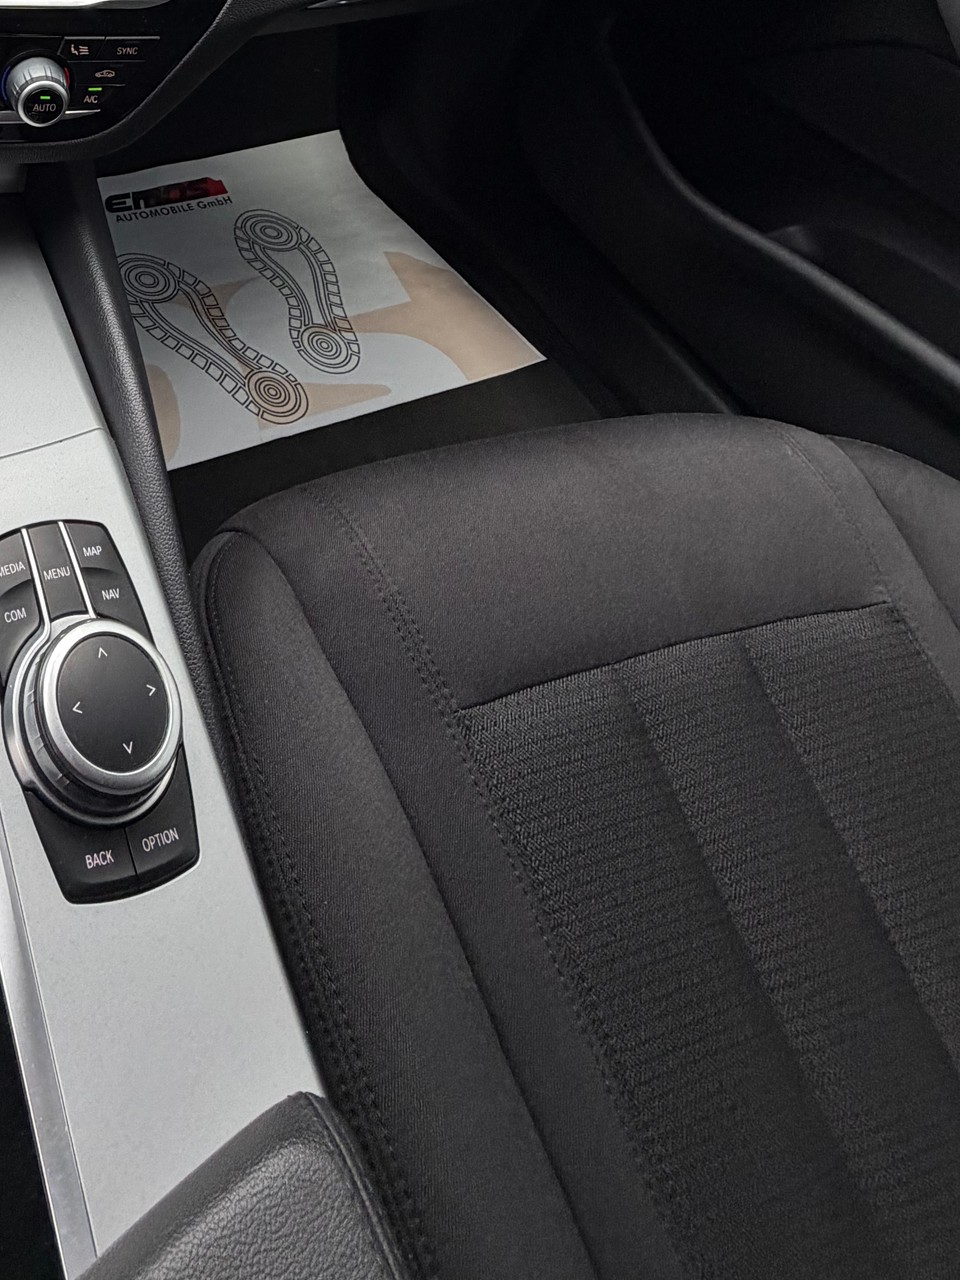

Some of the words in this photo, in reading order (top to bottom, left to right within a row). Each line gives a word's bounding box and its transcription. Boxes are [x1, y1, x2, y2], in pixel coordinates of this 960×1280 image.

[116, 47, 138, 55] SYNC
[83, 95, 98, 104] A/C
[32, 103, 56, 112] AUTO
[116, 203, 194, 222] AUTOMOBILE
[197, 196, 233, 210] GmbH
[82, 545, 103, 558] MAP
[43, 566, 71, 581] MENU
[101, 588, 121, 601] NAV
[3, 607, 27, 623] COM
[141, 827, 179, 852] OPTION
[85, 850, 115, 870] BACK
